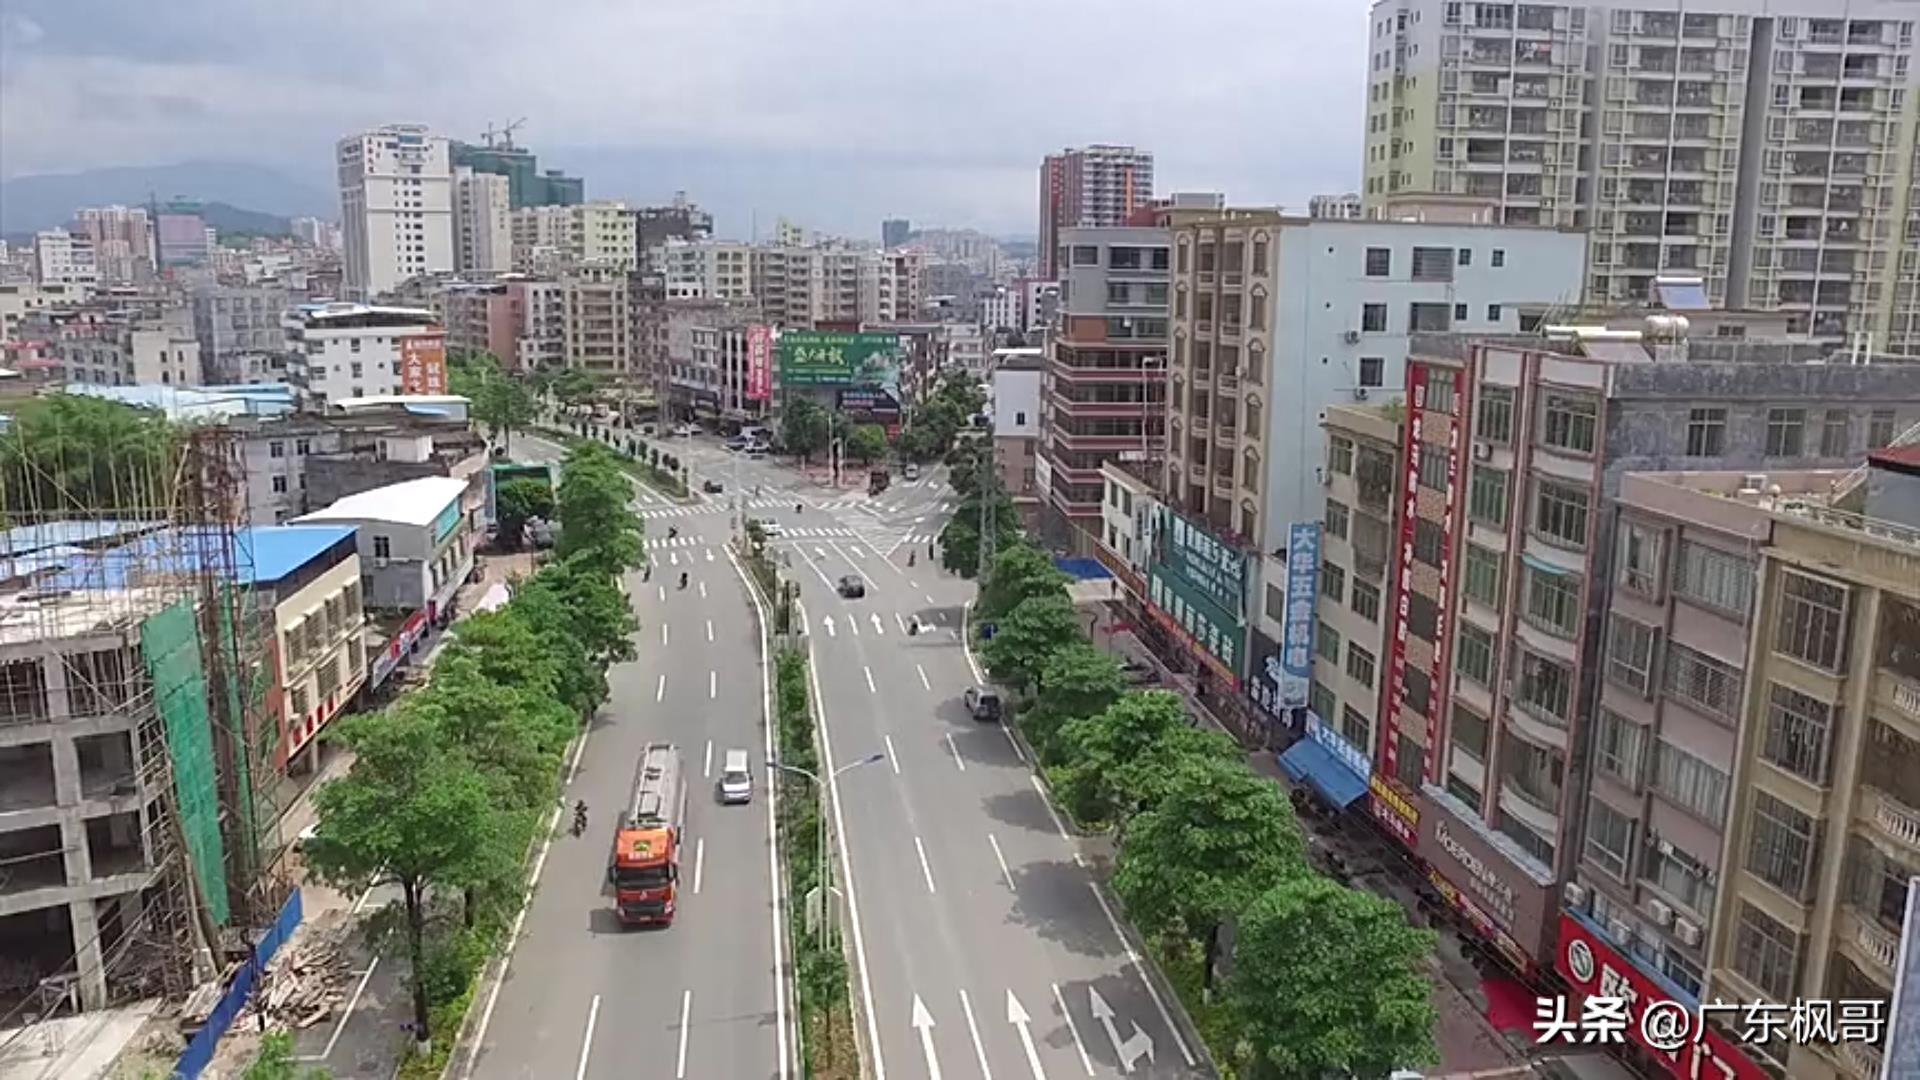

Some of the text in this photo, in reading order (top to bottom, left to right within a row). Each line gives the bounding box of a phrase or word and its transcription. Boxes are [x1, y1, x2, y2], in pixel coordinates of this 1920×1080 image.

[1287, 528, 1316, 668] 大华五金机电
